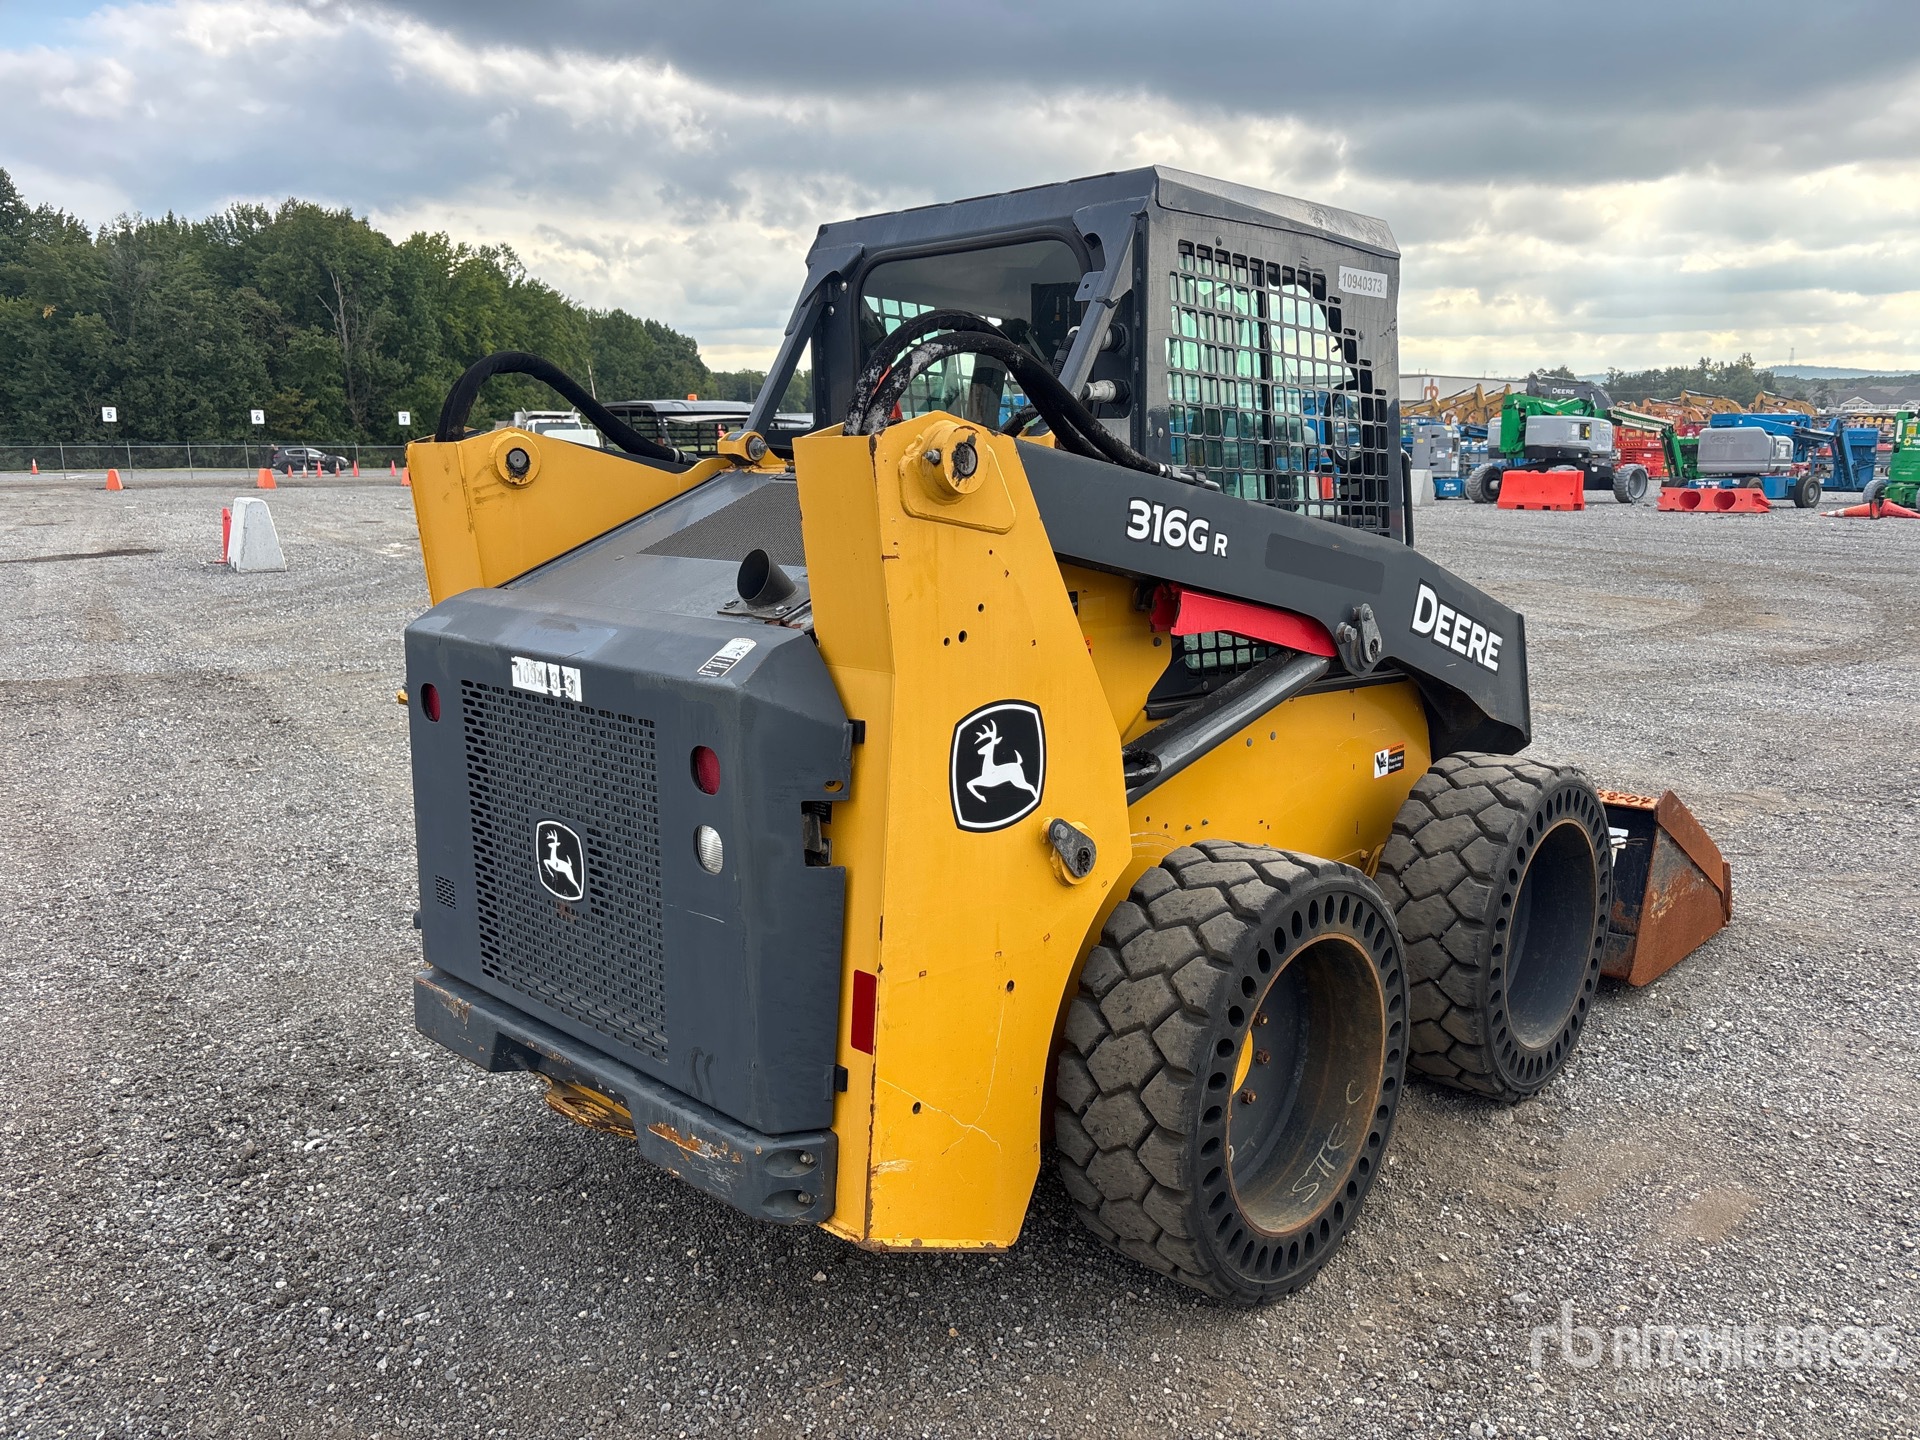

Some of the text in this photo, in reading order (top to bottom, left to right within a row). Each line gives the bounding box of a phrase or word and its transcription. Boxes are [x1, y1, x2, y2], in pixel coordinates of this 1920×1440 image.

[1342, 272, 1383, 293] 10940373
[1551, 387, 1576, 395] DEERE
[106, 411, 113, 419] 5
[255, 414, 261, 422] 6
[1126, 498, 1229, 557] 316G R
[1411, 583, 1504, 673] DEERE
